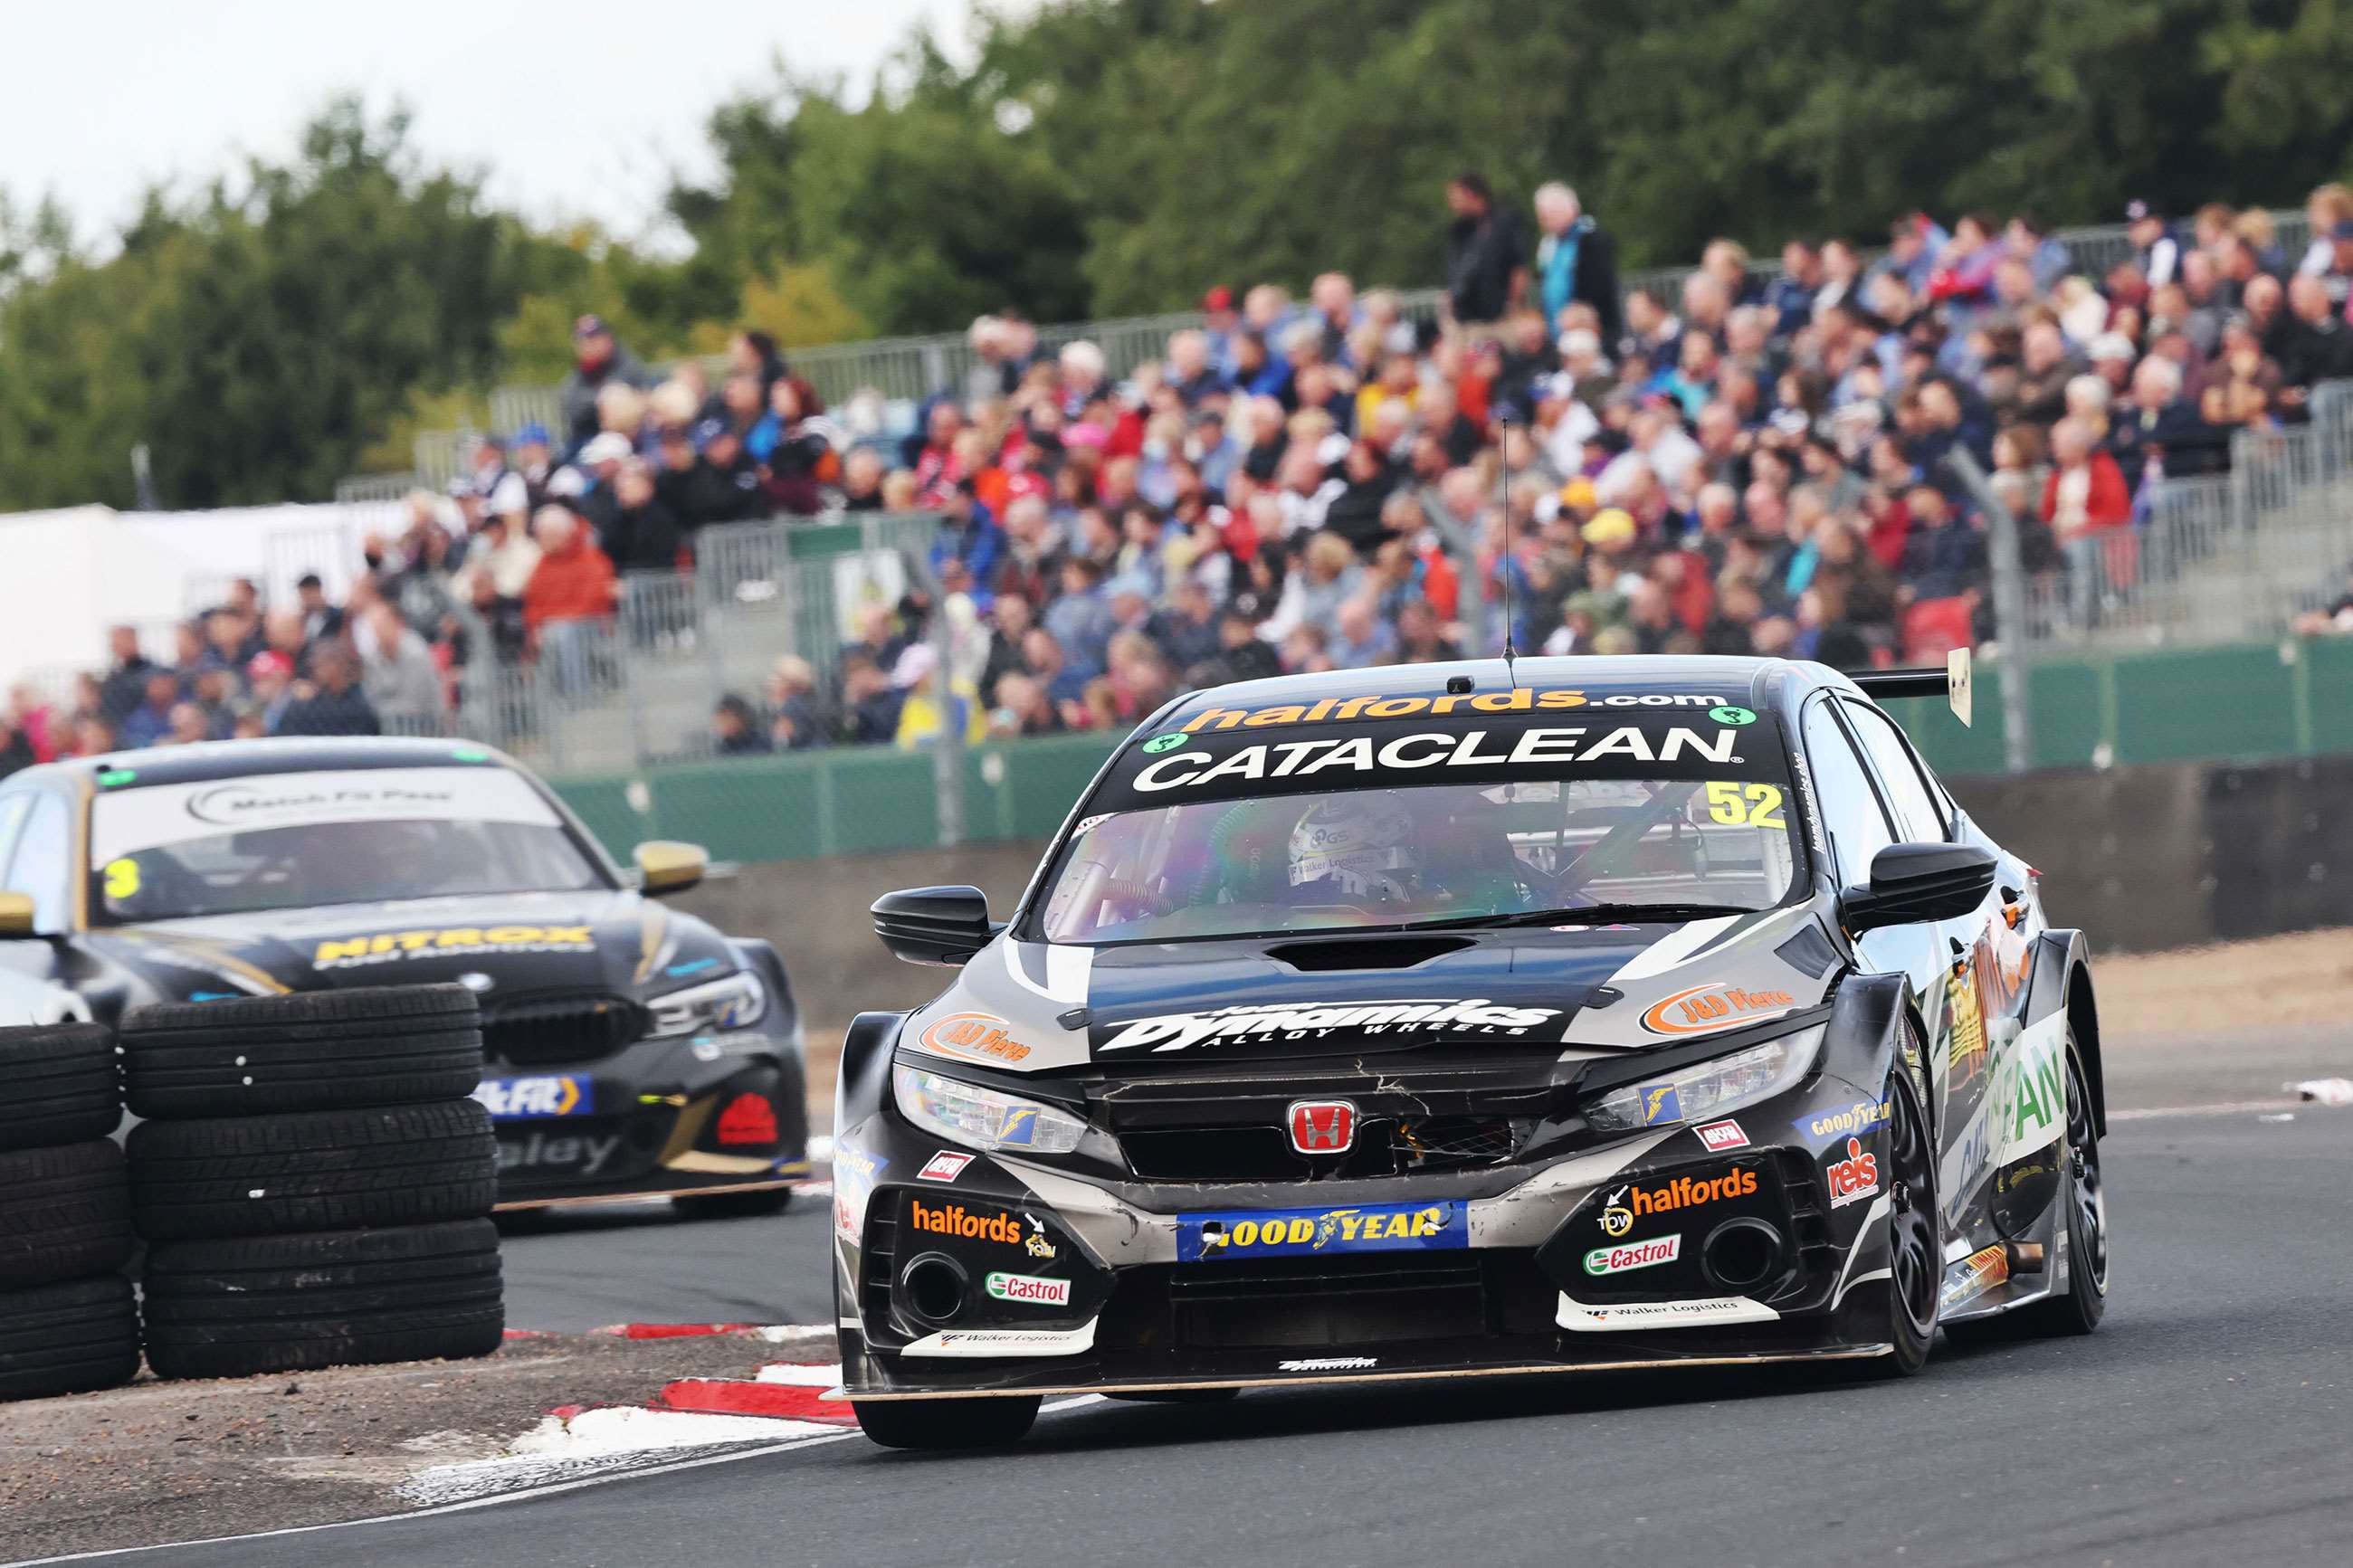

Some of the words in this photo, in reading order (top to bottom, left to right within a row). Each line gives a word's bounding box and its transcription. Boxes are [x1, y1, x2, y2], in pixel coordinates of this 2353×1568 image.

[1180, 688, 1729, 733] halfords.com
[1705, 781, 1786, 830] 52
[104, 858, 140, 898] 3
[316, 926, 595, 961] NITROX
[1679, 994, 1729, 1023] J&D
[1202, 1027, 1337, 1048] ALLOY
[1363, 1022, 1529, 1036] WHEELS
[1827, 1137, 1878, 1200] reis
[1631, 1167, 1758, 1216] halfords
[912, 1200, 1021, 1244] halfords
[1611, 1240, 1673, 1269] Castrol
[1007, 1278, 1064, 1301] Castrol
[1615, 1306, 1667, 1316] Walker
[1673, 1301, 1738, 1313] Logistics
[966, 1334, 1011, 1342] Walker
